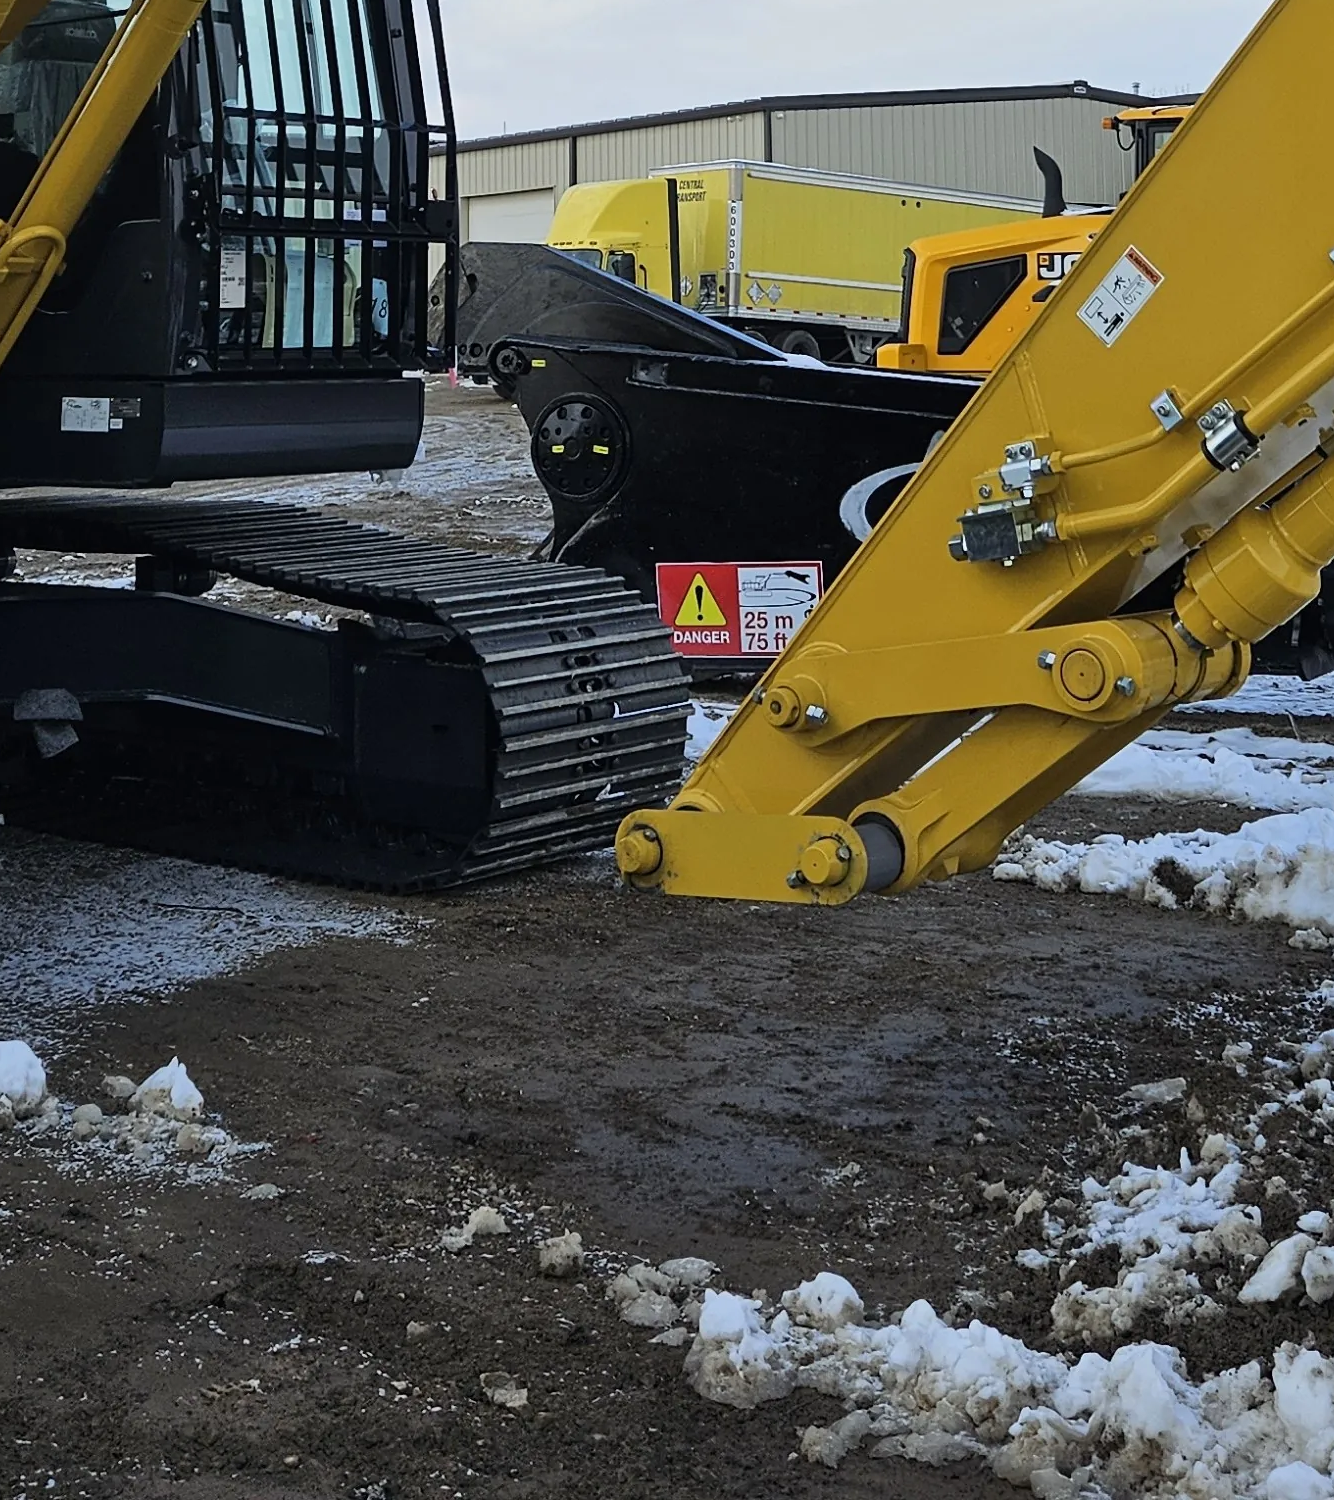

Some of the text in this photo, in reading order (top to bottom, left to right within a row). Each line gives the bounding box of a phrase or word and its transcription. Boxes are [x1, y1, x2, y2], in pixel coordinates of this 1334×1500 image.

[679, 180, 704, 190] CENTRAL
[677, 191, 707, 202] ANSPORT
[728, 206, 736, 270] 600303
[1039, 254, 1083, 278] JC
[744, 612, 793, 629] 25 m
[673, 631, 730, 644] DANGER
[745, 632, 788, 650] 75 ft
